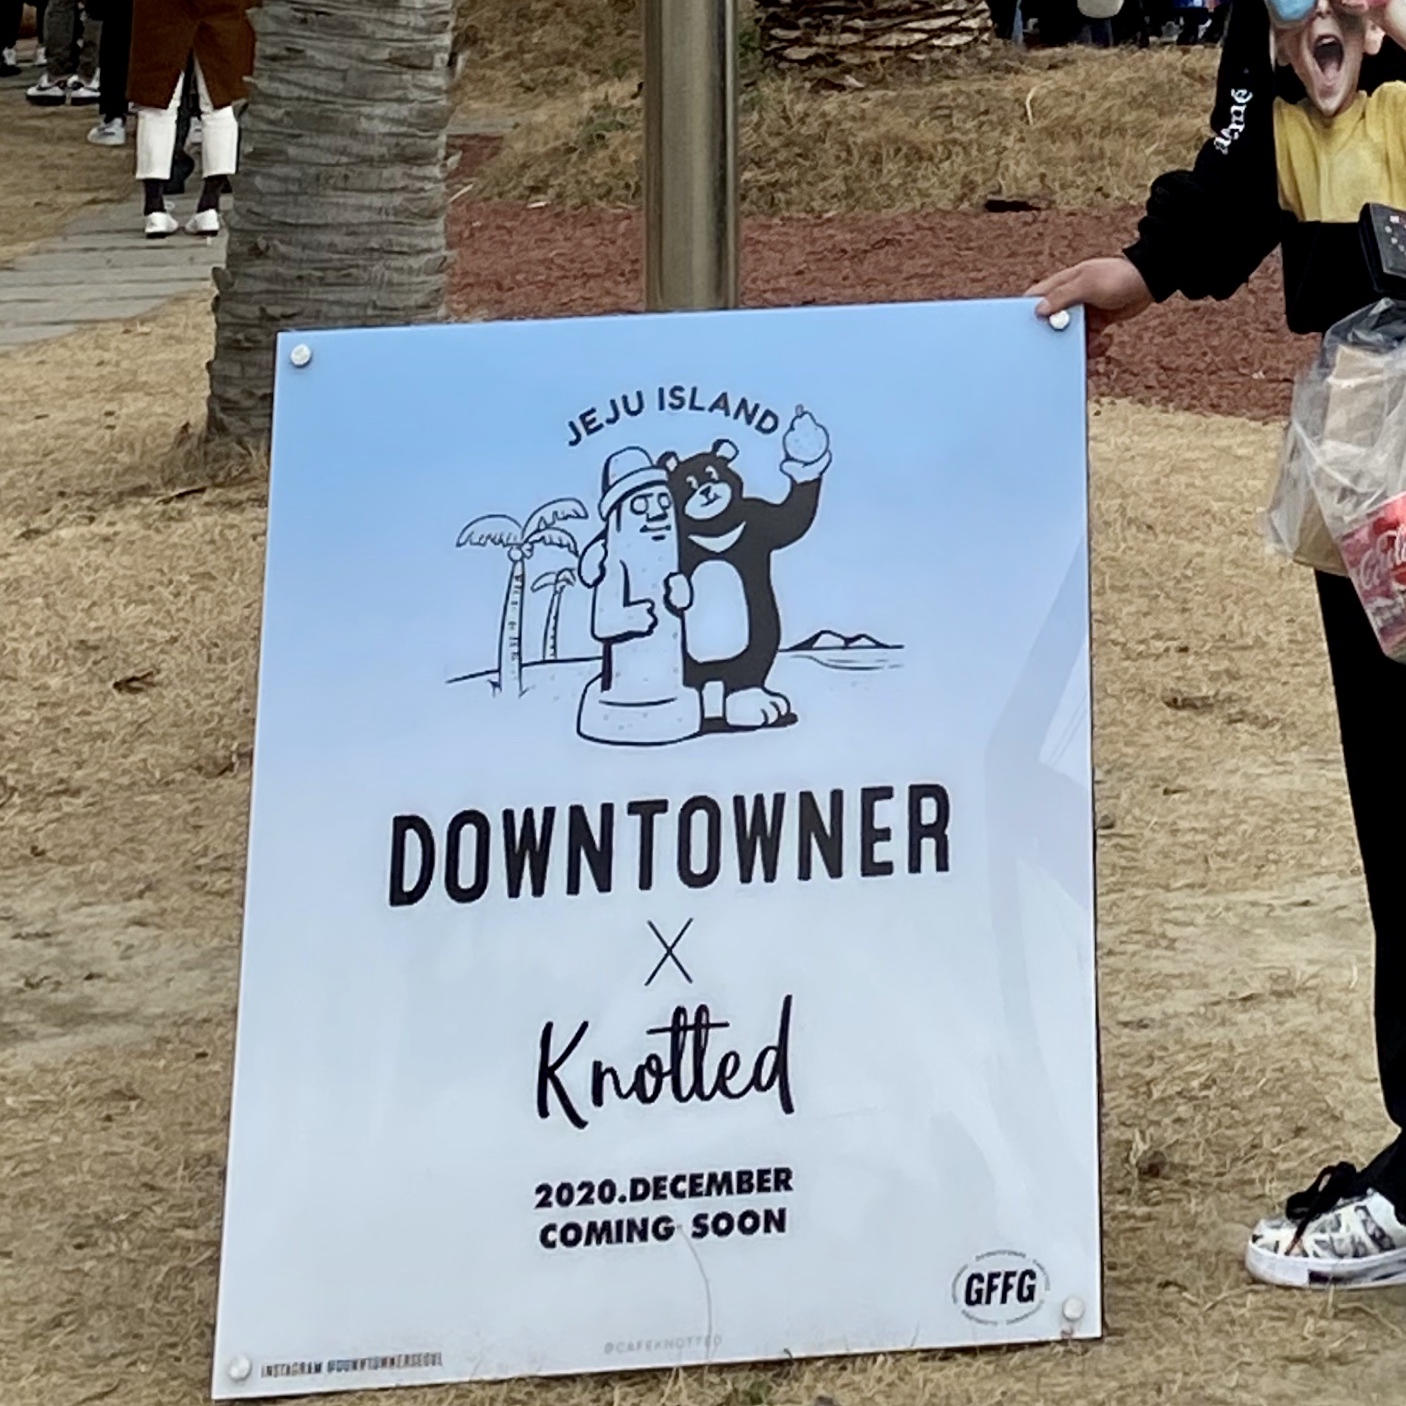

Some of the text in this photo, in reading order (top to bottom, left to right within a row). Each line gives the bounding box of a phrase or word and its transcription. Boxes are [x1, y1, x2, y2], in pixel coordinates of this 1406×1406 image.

[566, 385, 780, 446] JEJU ISLAND
[388, 783, 950, 907] DOWNTOWNER
[536, 994, 795, 1130] Knotted
[533, 1166, 794, 1210] 2020.DECEMBER
[538, 1206, 788, 1250] COMING SOON
[964, 1268, 1037, 1307] GFFG
